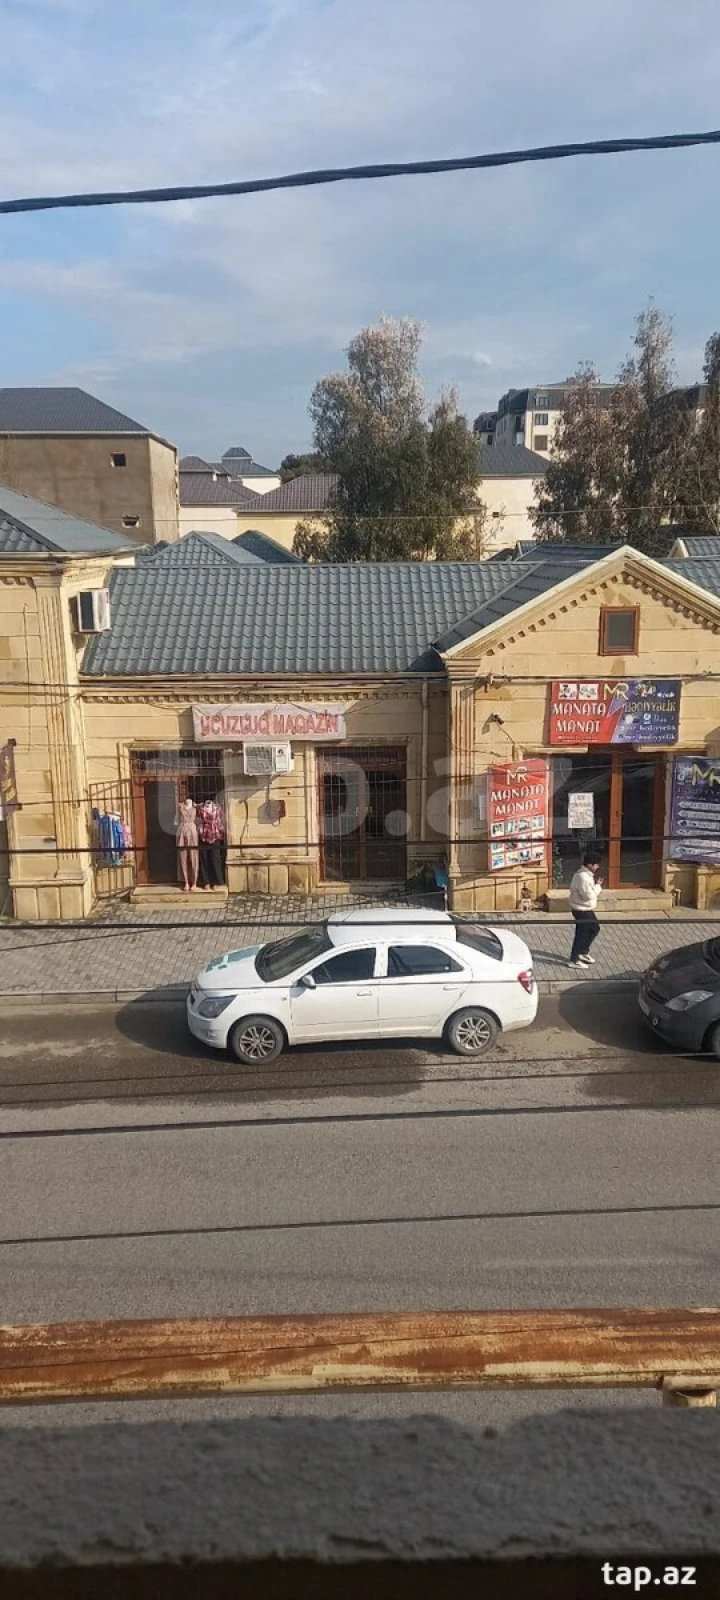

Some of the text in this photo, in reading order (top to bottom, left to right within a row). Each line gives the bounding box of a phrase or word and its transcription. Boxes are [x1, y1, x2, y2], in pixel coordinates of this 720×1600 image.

[603, 682, 629, 701] MR
[553, 702, 607, 716] MANATA
[555, 719, 601, 734] MANAT
[506, 766, 528, 785] MR
[490, 784, 545, 802] MANATA
[495, 799, 541, 815] MANAT
